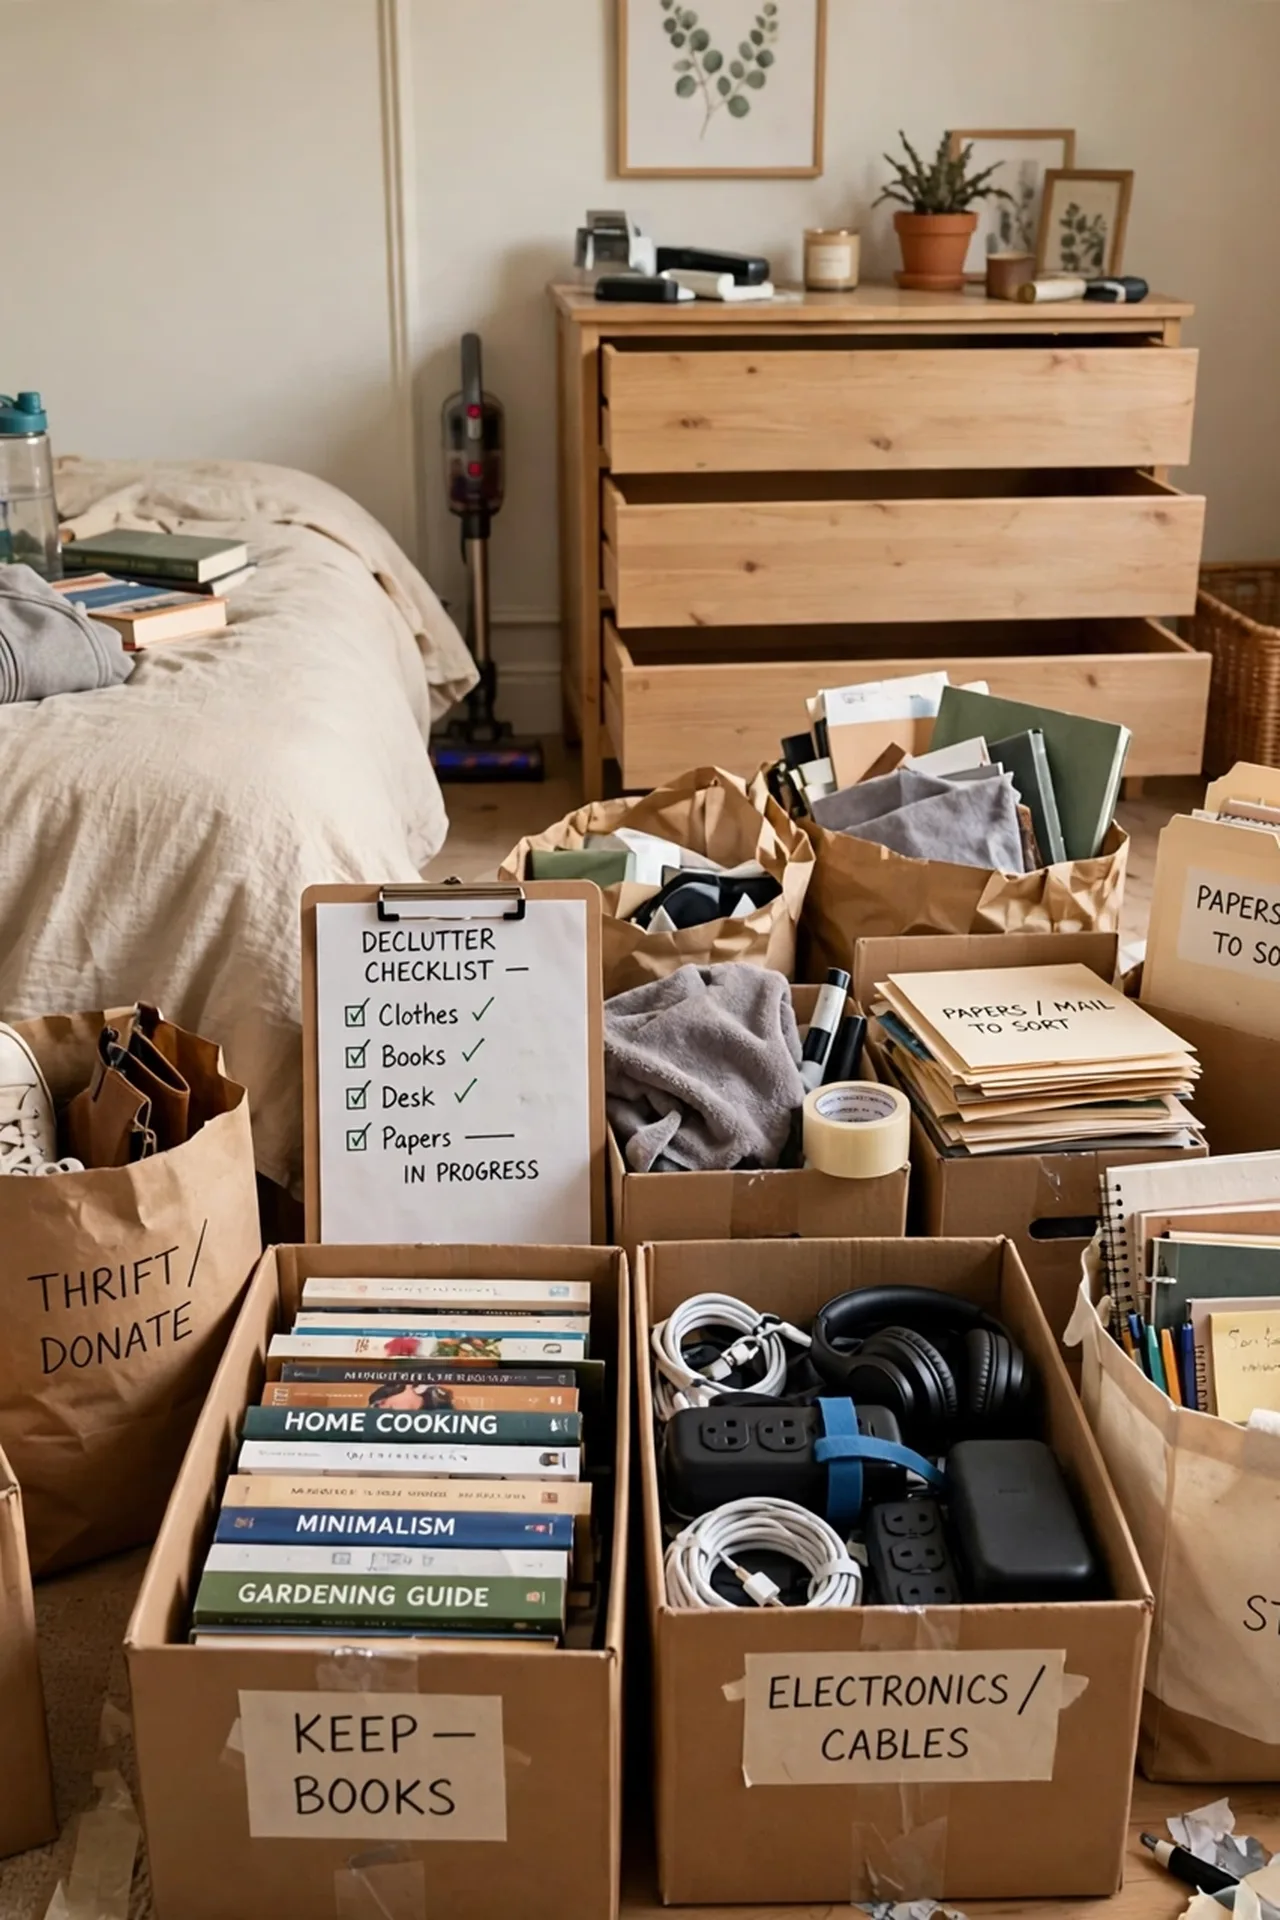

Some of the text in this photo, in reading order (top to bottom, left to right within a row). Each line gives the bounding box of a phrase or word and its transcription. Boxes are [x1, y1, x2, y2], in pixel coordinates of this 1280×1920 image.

[1197, 884, 1280, 925] PAPERS
[362, 927, 496, 954] DECLUTTER
[1213, 931, 1280, 967] TO SO
[365, 959, 494, 984] CHECKLIST
[379, 1001, 459, 1027] Clothes
[942, 1005, 1027, 1020] PAPERS
[1053, 998, 1117, 1013] MAIL
[967, 1018, 1070, 1035] TO SORT
[382, 1044, 446, 1068] Books
[382, 1085, 435, 1109] Desk
[383, 1125, 451, 1156] Papers
[404, 1158, 541, 1184] IN PROGRESS
[40, 1300, 193, 1375] DONATE
[284, 1411, 497, 1435] HOME COOKING
[296, 1514, 456, 1536] MINIMALISM
[238, 1582, 490, 1608] GARDENING GUIDE
[769, 1674, 1008, 1710] ELECTRONICS
[294, 1712, 418, 1754] KEEP
[821, 1727, 969, 1761] CABLES
[294, 1775, 455, 1816] BOOKS
